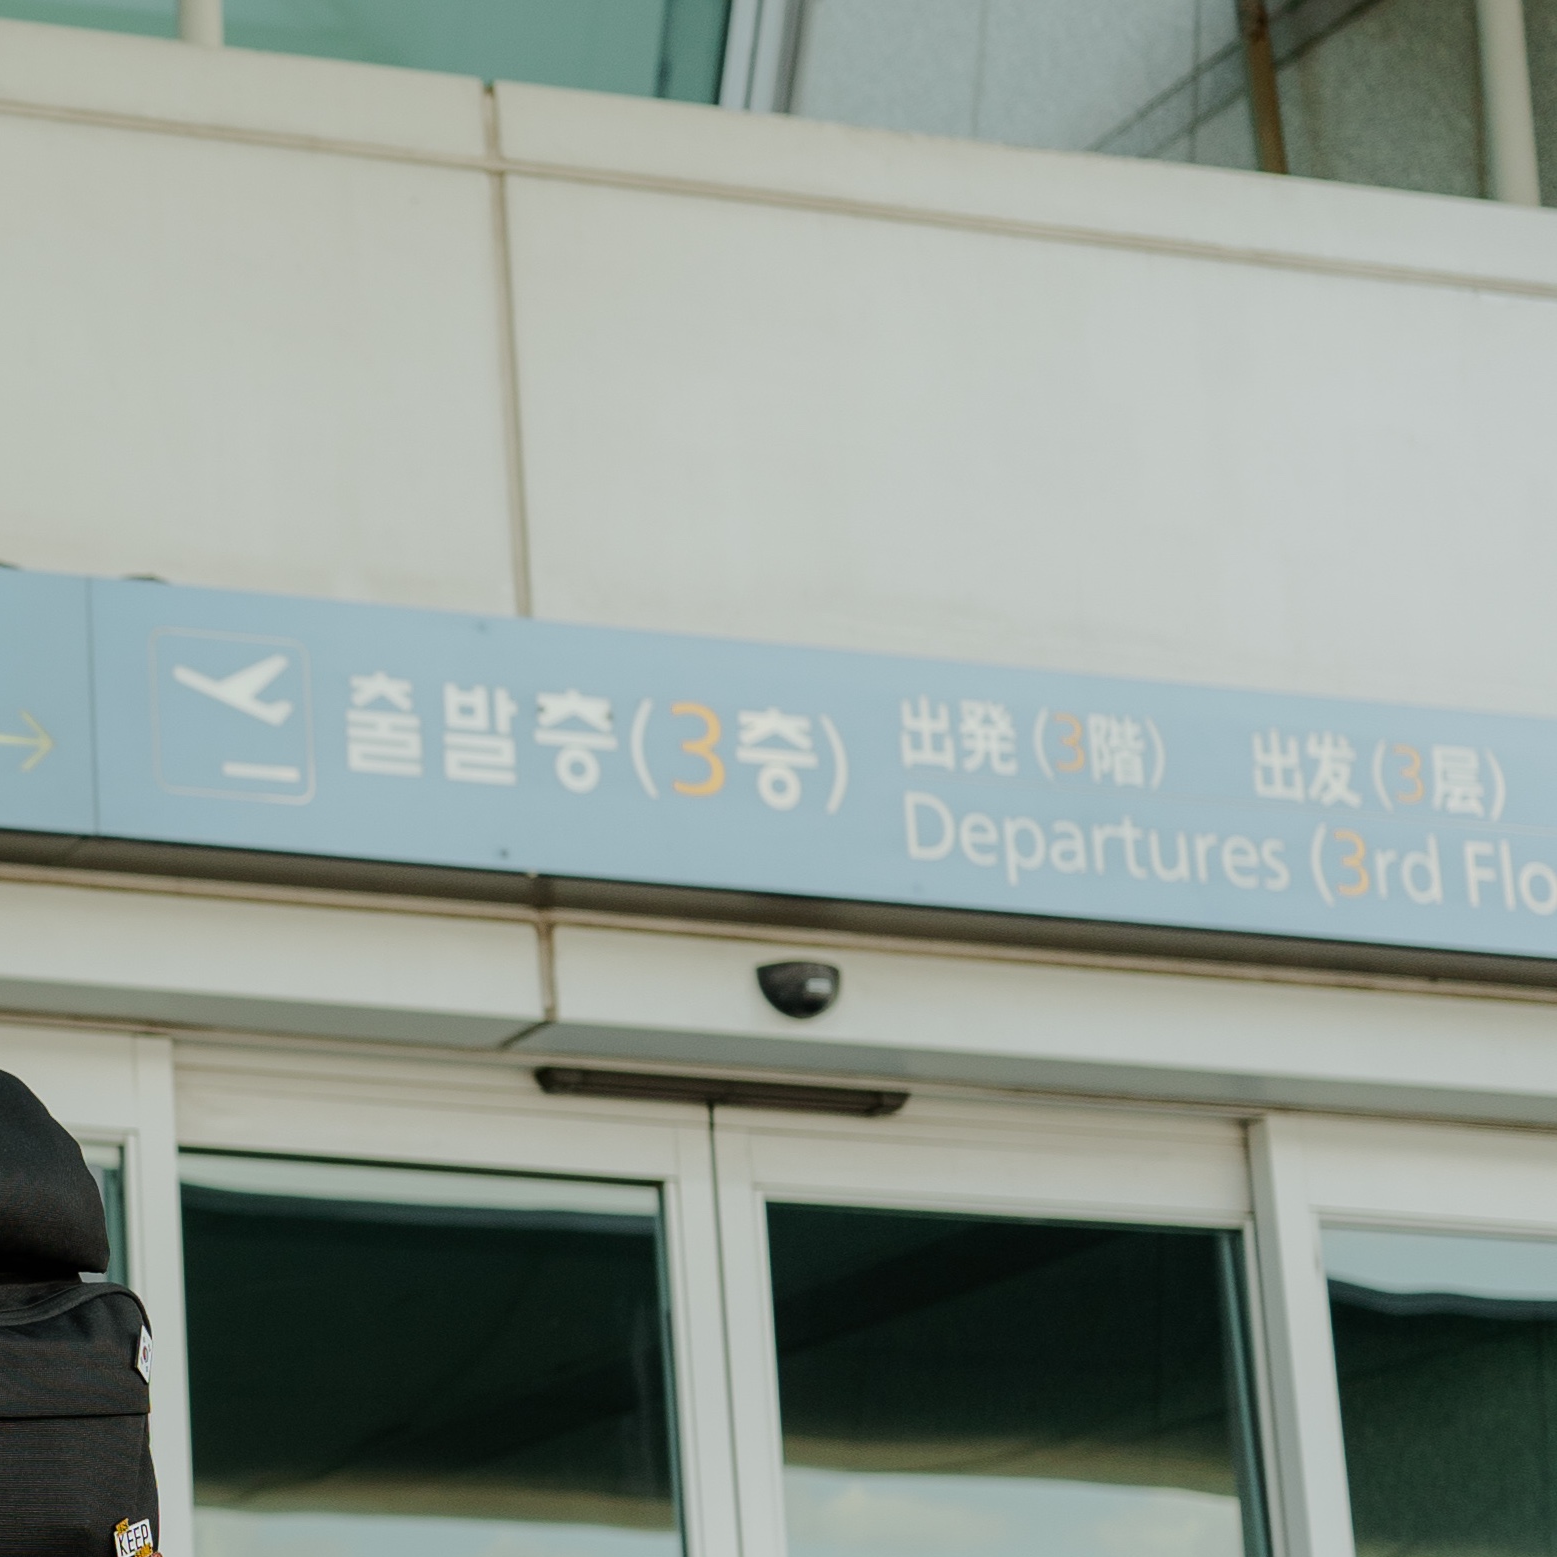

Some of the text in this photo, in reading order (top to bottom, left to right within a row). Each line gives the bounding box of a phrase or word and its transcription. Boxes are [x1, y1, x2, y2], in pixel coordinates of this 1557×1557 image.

[346, 671, 849, 815] 출발층(3층)
[903, 790, 1557, 916] Departures (3rd Flo
[118, 1523, 149, 1557] KEEP
